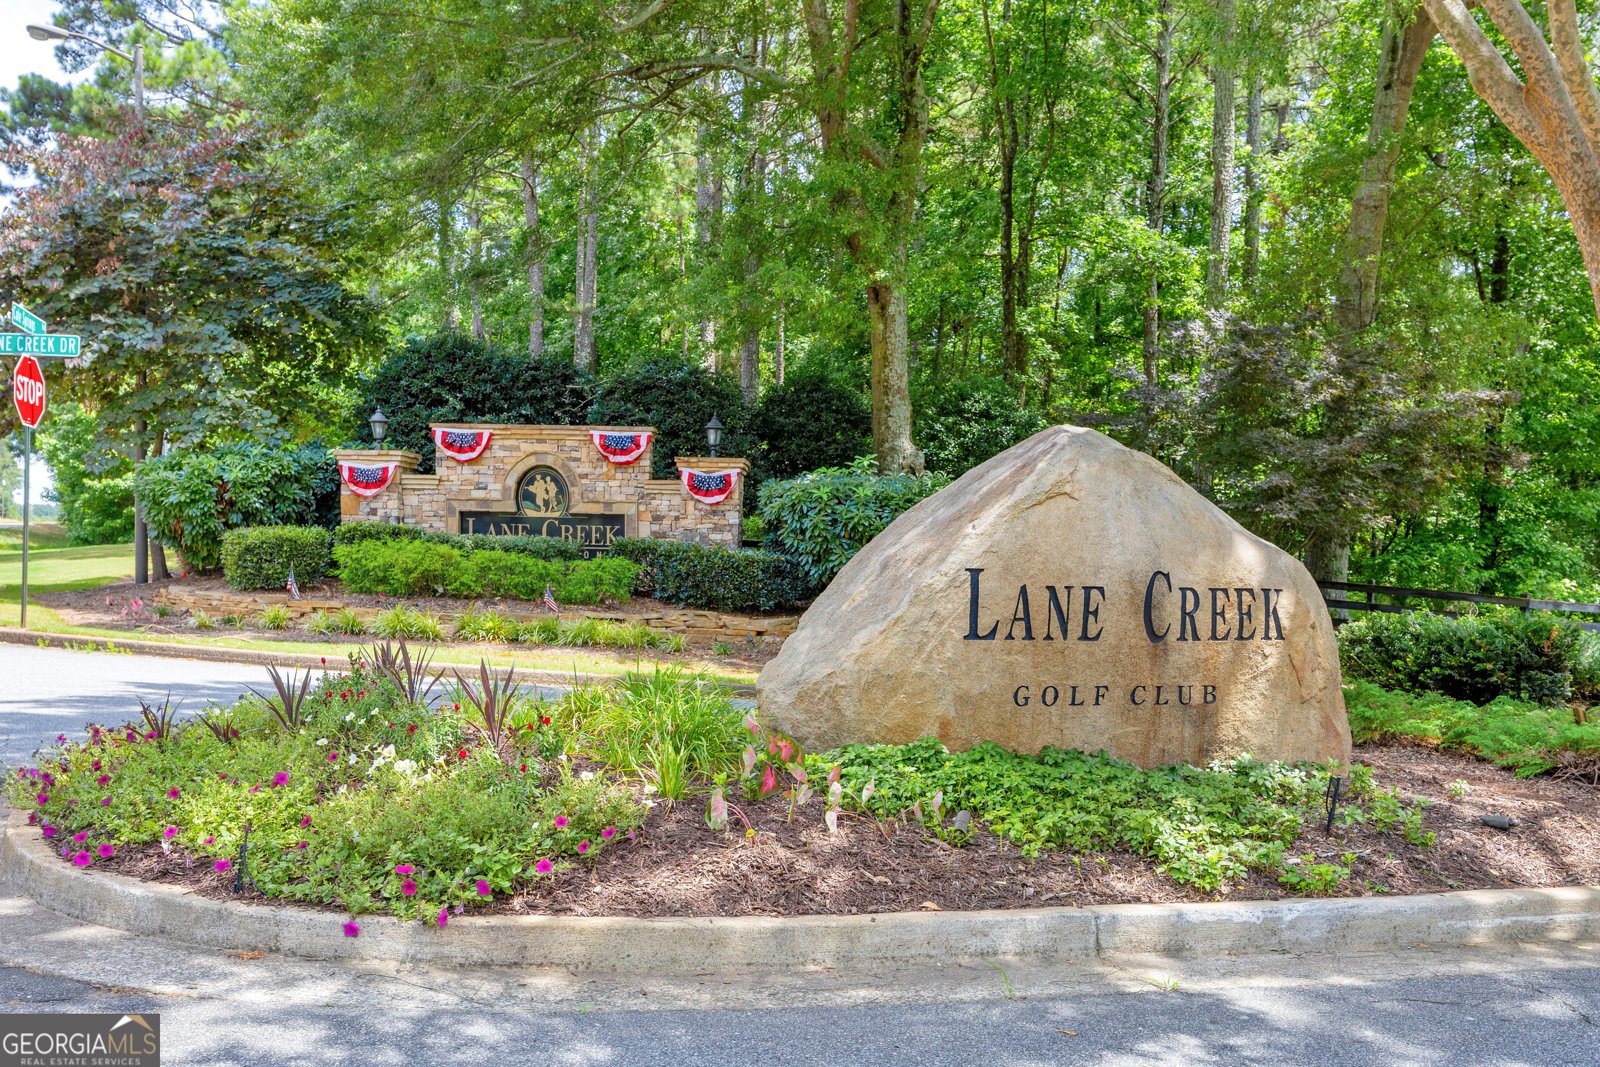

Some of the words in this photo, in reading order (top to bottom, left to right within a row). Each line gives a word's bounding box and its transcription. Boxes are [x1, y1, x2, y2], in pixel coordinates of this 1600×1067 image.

[16, 336, 55, 353] CREEK
[60, 337, 76, 353] DR
[16, 374, 43, 407] STOP
[541, 519, 621, 546] CREEK
[963, 568, 1106, 642] LANE
[1143, 570, 1286, 644] CREEK
[1013, 685, 1109, 707] GOLF
[1129, 685, 1218, 706] CLUB
